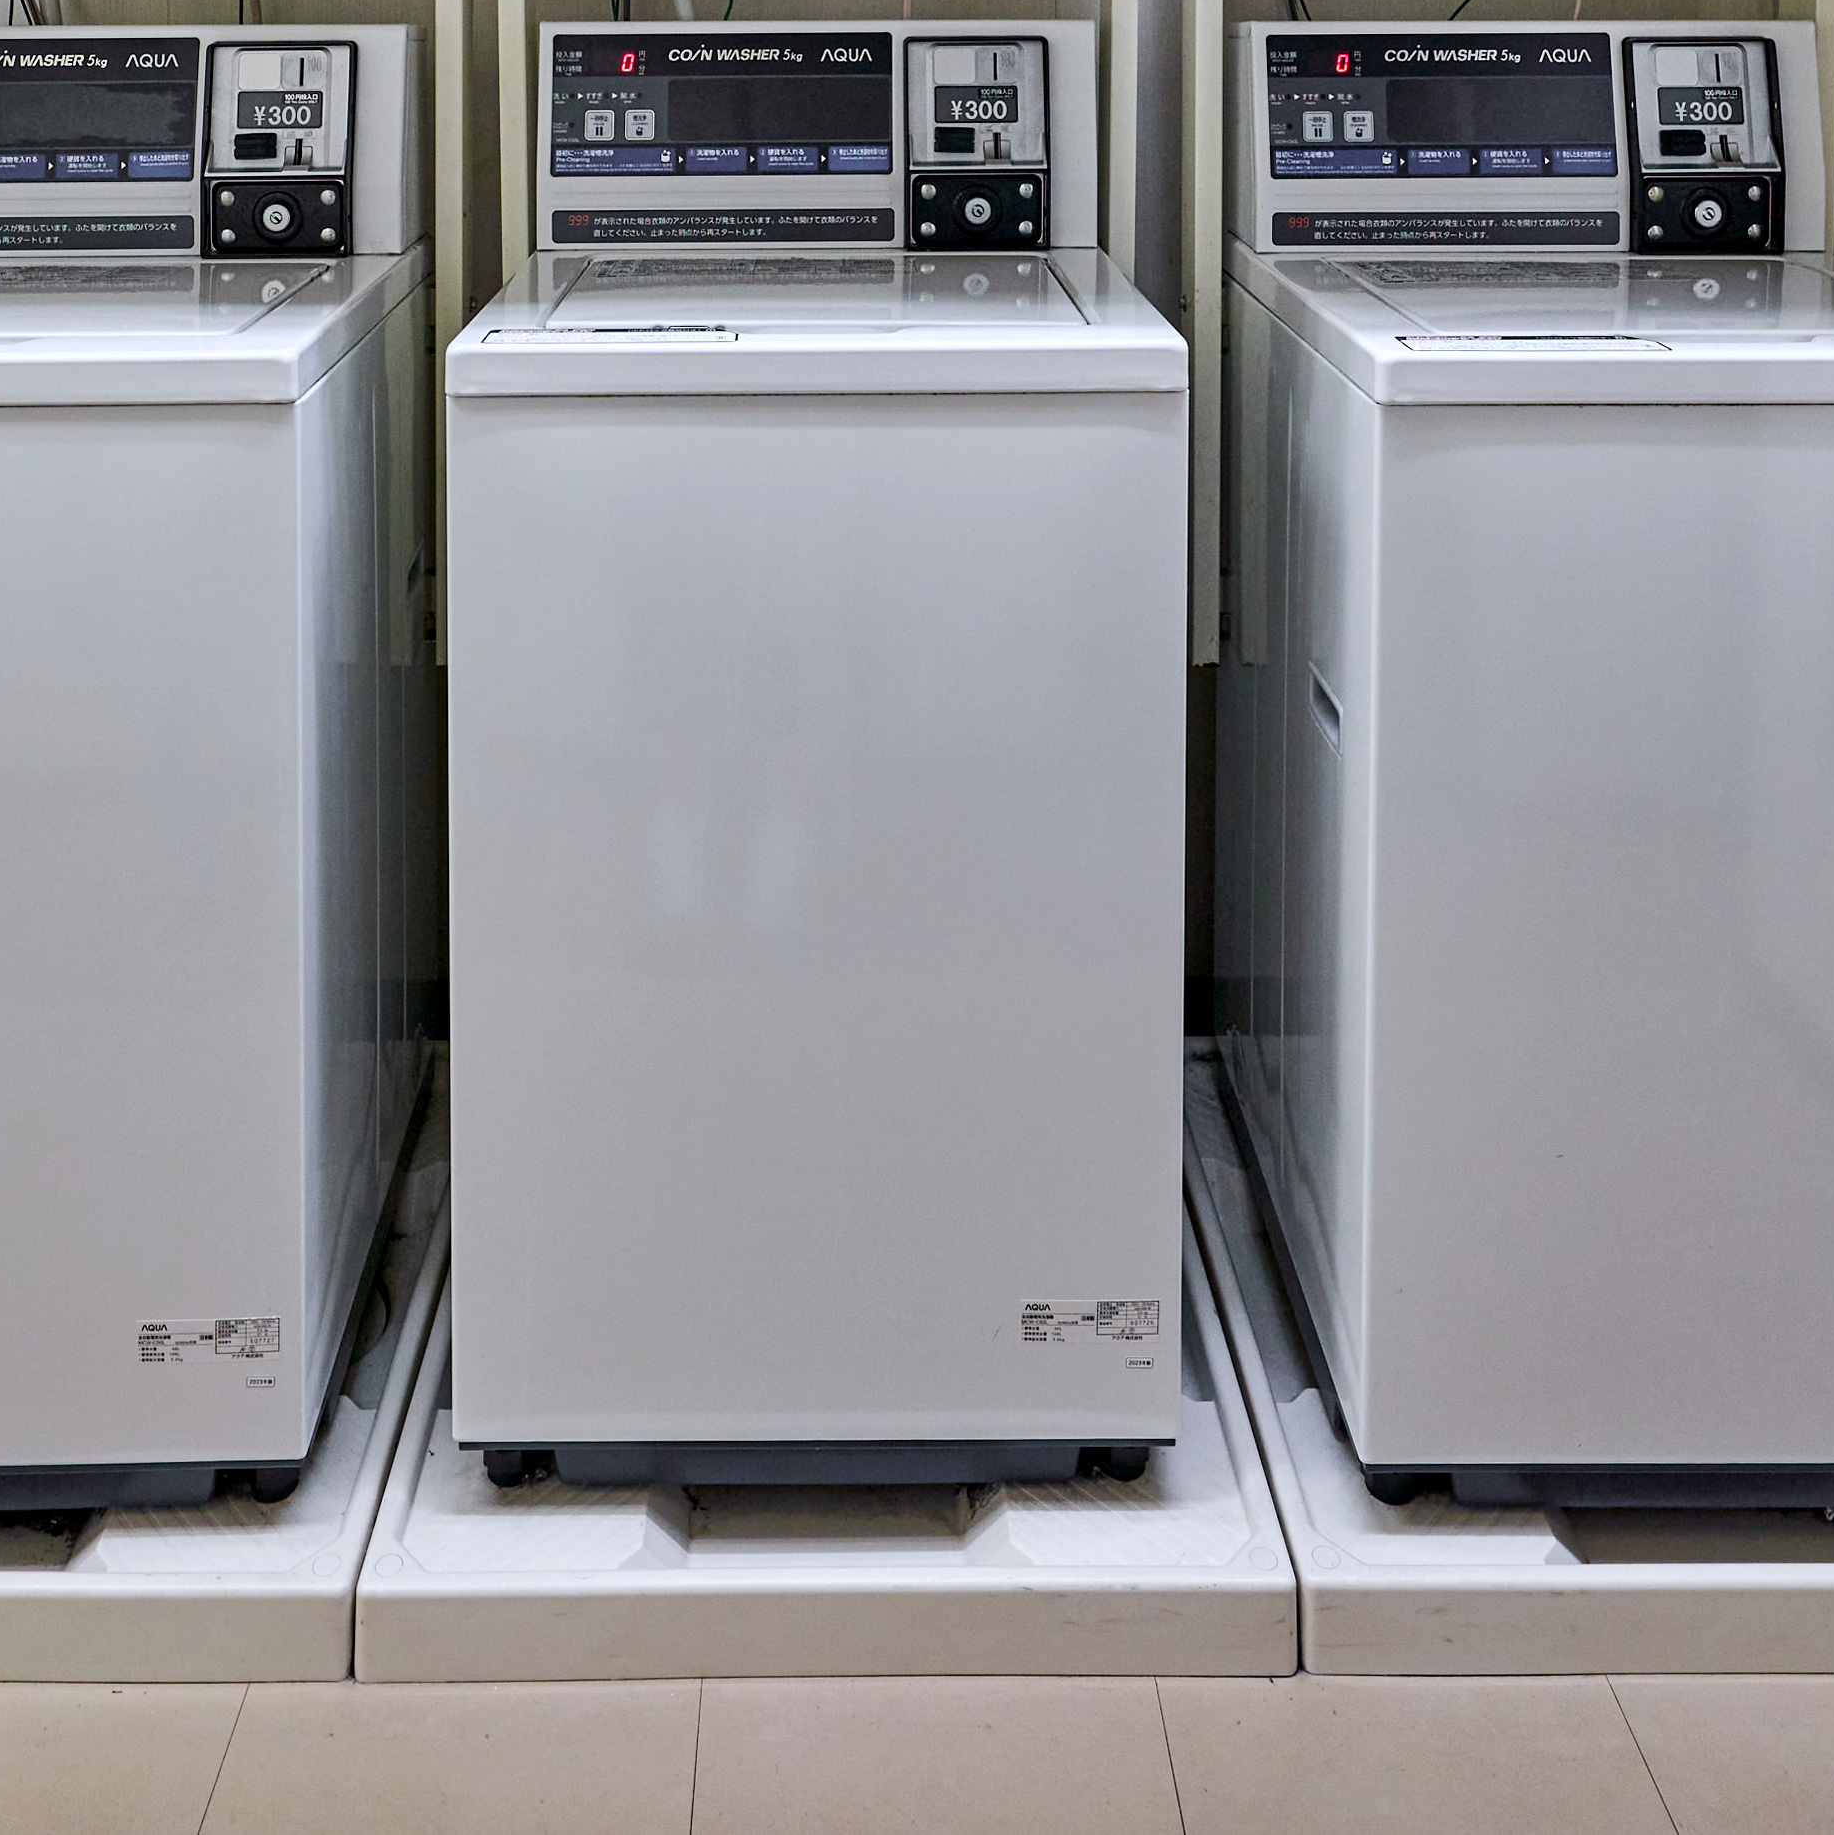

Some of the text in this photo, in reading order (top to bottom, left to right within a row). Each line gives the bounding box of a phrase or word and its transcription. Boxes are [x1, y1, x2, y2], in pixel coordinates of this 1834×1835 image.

[20, 55, 84, 66] WASHER
[87, 55, 107, 68] 5kg
[125, 54, 179, 67] AQUA
[668, 44, 803, 62] COIN WASHER 5kg
[820, 49, 872, 62] AQUA
[1385, 44, 1521, 63] COIN WASHER 5kg
[1539, 49, 1592, 63] AQUA
[621, 54, 634, 72] 0
[1335, 54, 1349, 72] 0
[254, 106, 311, 125] ¥300
[951, 100, 1007, 120] ¥300
[1675, 102, 1732, 121] ¥300
[569, 215, 588, 226] 999
[1289, 218, 1309, 228] 999
